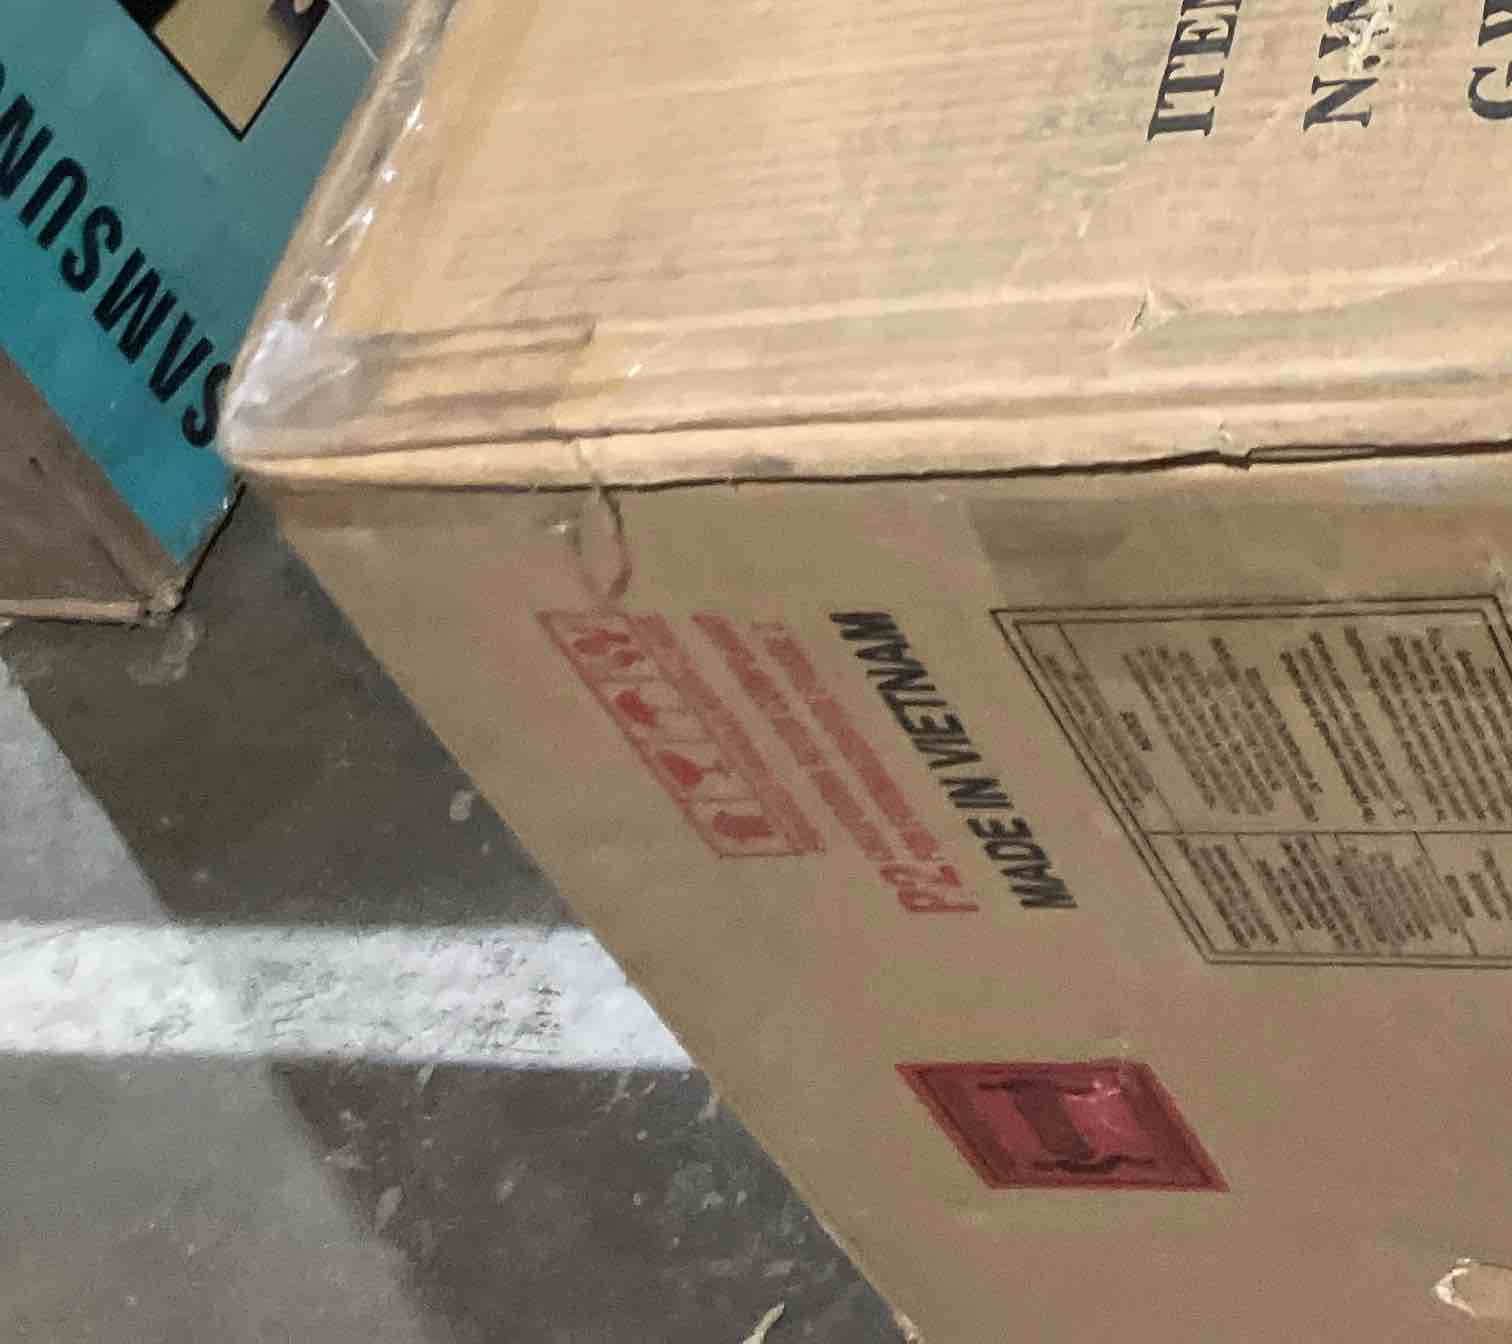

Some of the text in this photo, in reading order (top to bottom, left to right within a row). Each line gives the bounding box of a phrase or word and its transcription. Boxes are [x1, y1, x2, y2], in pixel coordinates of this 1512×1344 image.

[0, 58, 231, 449] SAMSUN
[830, 611, 1077, 910] MADE IN VIETNAM
